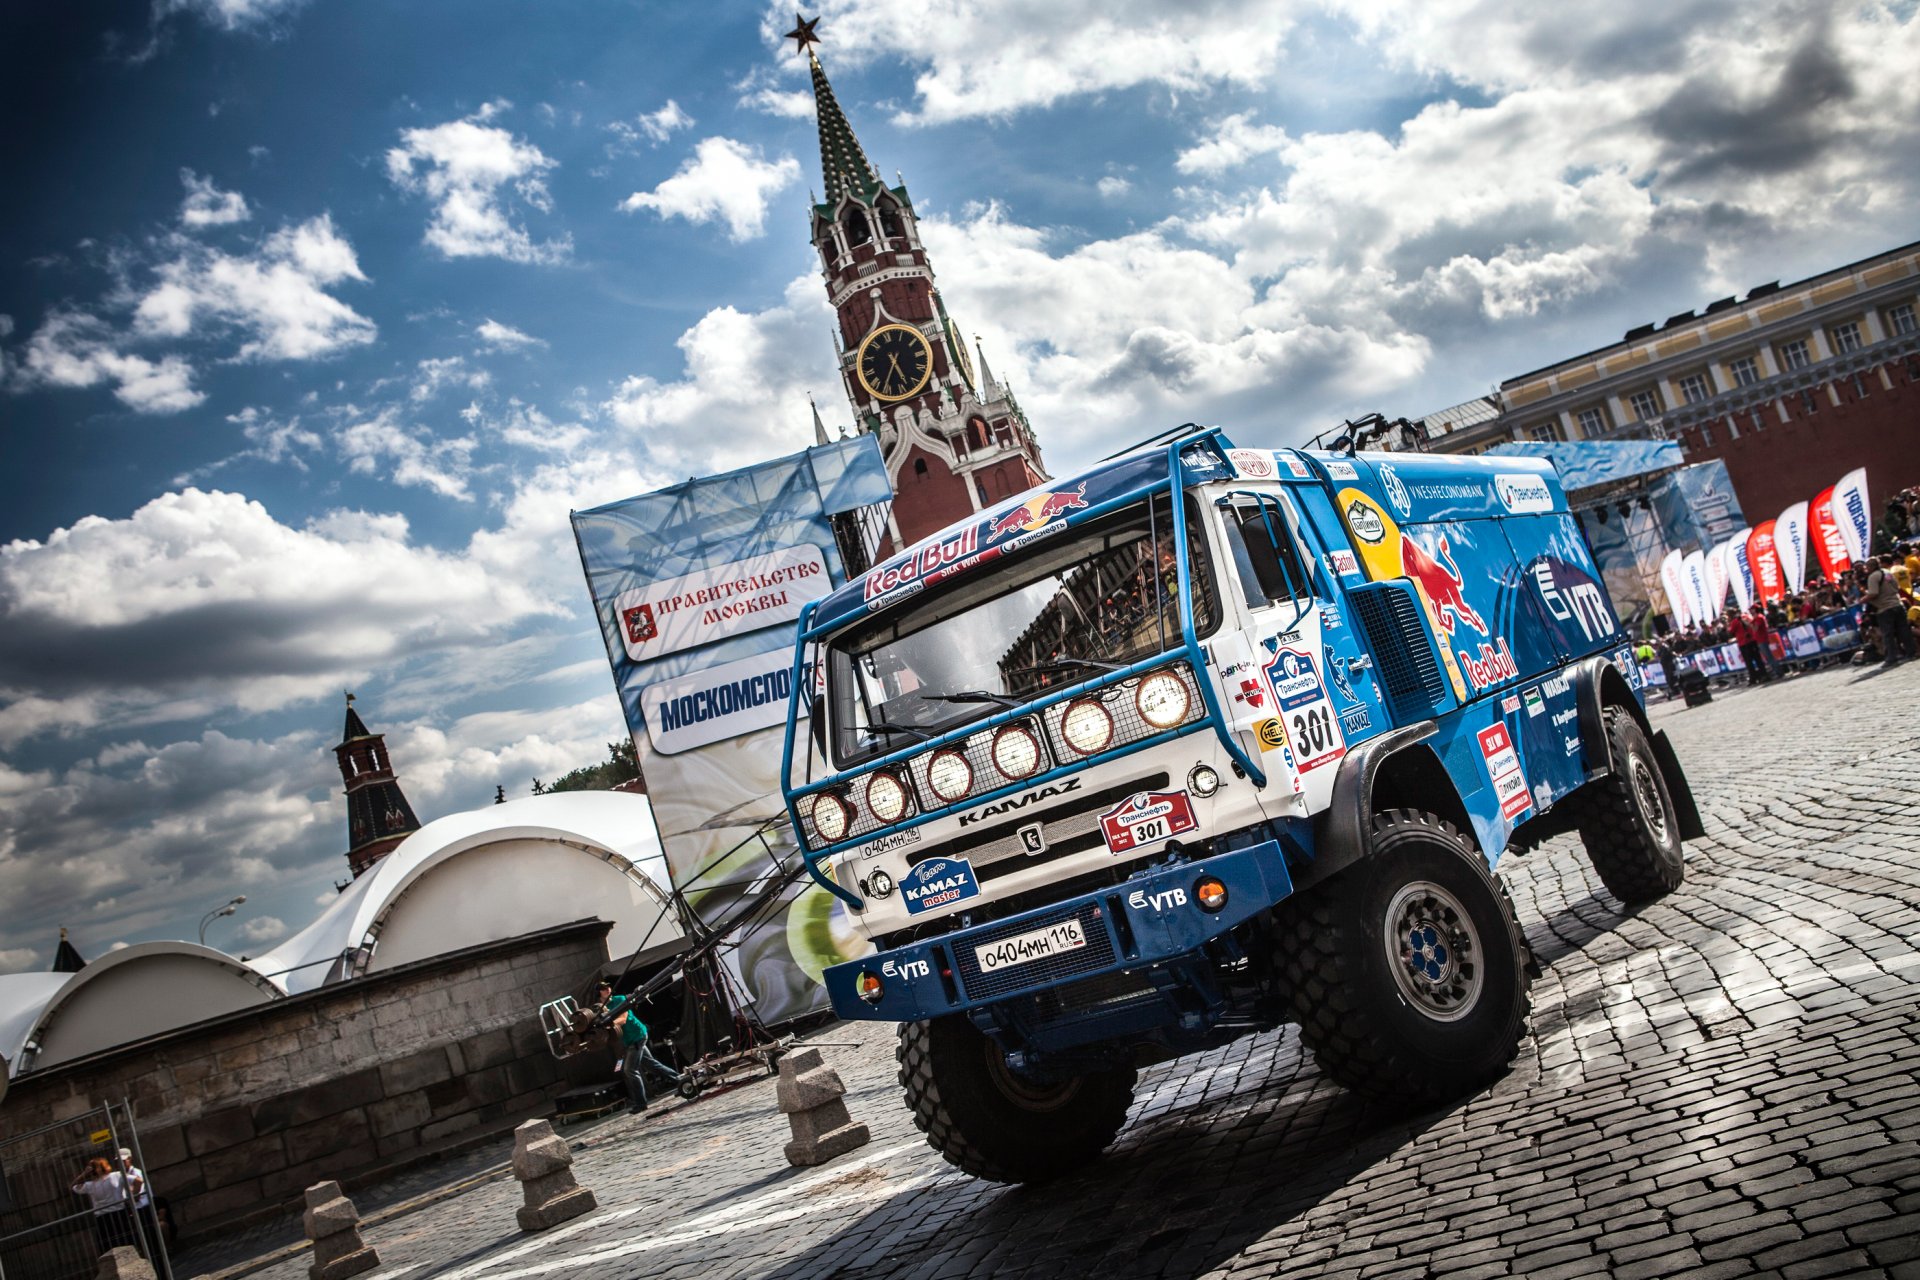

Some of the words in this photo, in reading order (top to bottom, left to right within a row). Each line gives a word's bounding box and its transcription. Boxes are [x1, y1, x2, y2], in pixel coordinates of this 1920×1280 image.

[1408, 485, 1486, 500] VNESHECONOMBANK
[1508, 485, 1551, 501] Транснефть
[1017, 521, 1066, 546] Транснефть
[865, 553, 918, 601] Red
[922, 526, 978, 572] Bull
[941, 563, 957, 578] SILK
[960, 556, 981, 571] WAY
[1331, 553, 1357, 573] Castrol
[657, 561, 820, 616] ПРАВИТЕЛЬСТВО
[881, 583, 922, 604] Транснефть
[703, 591, 789, 626] МОСКВЫ
[1562, 582, 1614, 642] VTB
[1460, 643, 1492, 689] Red
[1485, 637, 1519, 683] Bull
[659, 661, 812, 733] МОСКОМСПОТ
[1279, 676, 1316, 696] Транснефть
[1294, 706, 1334, 757] 301
[1344, 710, 1371, 734] KAMAZ
[958, 777, 1082, 827] KAMAZ
[1120, 804, 1169, 823] Транснефть
[1137, 820, 1163, 841] 301
[915, 862, 946, 883] Team
[906, 873, 968, 901] KAMAZ
[922, 889, 960, 908] master
[1147, 888, 1188, 912] VTB
[1050, 925, 1078, 944] 116
[1059, 941, 1073, 949] RUS
[898, 960, 930, 980] VTB
